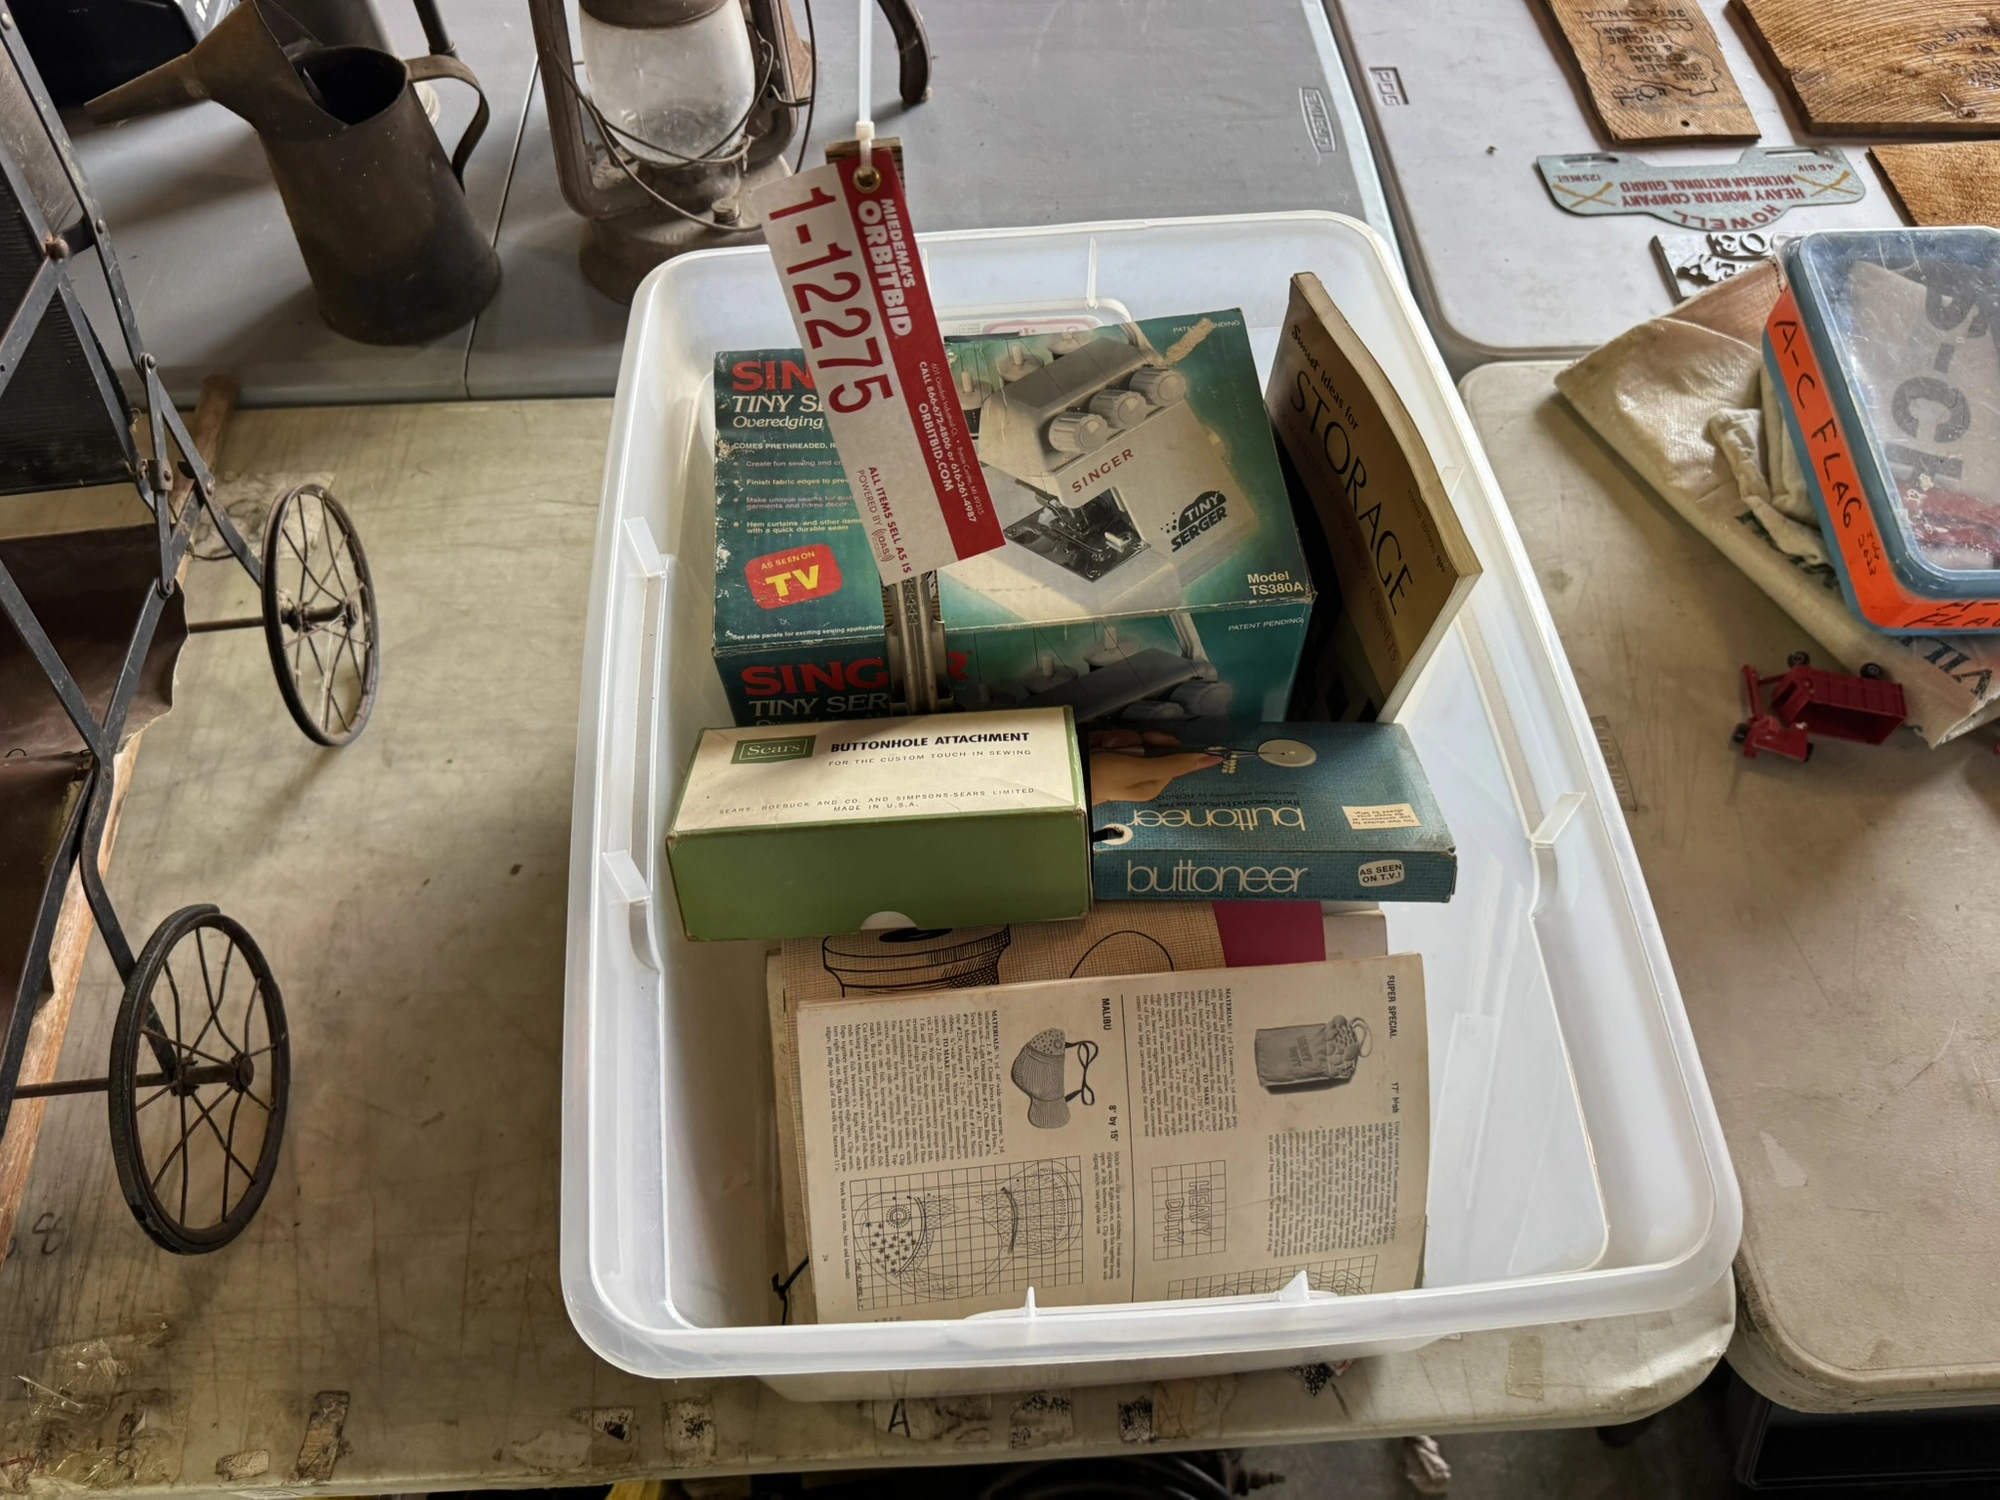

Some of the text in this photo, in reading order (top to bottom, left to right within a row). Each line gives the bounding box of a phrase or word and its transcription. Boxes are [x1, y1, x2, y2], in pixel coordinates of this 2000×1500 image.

[1607, 35, 1664, 44] ENGINE
[1619, 174, 1794, 193] MICHIGAN NATIONAL GUARD
[1621, 187, 1805, 207] HEAVY MORTAR COMPANY
[1671, 205, 1780, 230] HOWELL
[880, 197, 916, 289] MIEDEMA'S
[856, 200, 914, 338] ORBITBID
[768, 186, 894, 414] 1-12275
[732, 359, 817, 393] SIN
[1291, 323, 1360, 430] Sunset Ideas for
[732, 394, 796, 413] TINY
[733, 415, 824, 430] Overedging
[1773, 319, 1862, 529] A-C FLAG
[733, 442, 763, 450] COMES
[765, 442, 828, 450] PRETHREADED,
[918, 360, 977, 524] CALL 866-672-4806 or 616-261-4987
[918, 401, 954, 492] ORBITBID.COM
[745, 460, 771, 468] Create
[1071, 448, 1134, 494] SINGER
[796, 478, 820, 486] edges
[855, 468, 877, 514] POWERED
[871, 514, 882, 527] BY
[1290, 370, 1413, 615] STORAGE
[1184, 491, 1222, 520] TINY
[867, 464, 911, 574] ALL ITEMS SELL AS IS
[772, 526, 794, 535] quick
[1171, 505, 1229, 554] SERGER
[761, 551, 816, 570] AS SEEN ON
[765, 564, 821, 597] TV
[1247, 570, 1290, 585] Model
[1249, 581, 1304, 596] TS380A
[762, 631, 784, 639] panels
[795, 629, 821, 637] exciting
[821, 628, 845, 636] sewing
[1228, 617, 1303, 632] PATENT PENDING
[749, 692, 890, 717] TINY SER
[745, 740, 802, 757] Sears
[830, 732, 1030, 753] BUTTONHOLE ATTACHMENT
[880, 754, 926, 763] CUSTOM
[930, 751, 967, 760] TOUCH
[989, 749, 1032, 757] SEWING
[895, 789, 986, 802] SIMPSONS-SEARS
[992, 787, 1035, 796] LIMITED
[833, 801, 920, 813] MADE IN U.S.A.
[1130, 806, 1307, 832] buttoneer
[1126, 859, 1309, 893] buttoneer
[1359, 863, 1402, 876] AS SEEN
[1362, 875, 1377, 883] ON
[1101, 998, 1112, 1031] MALIBU
[1387, 974, 1398, 1039] SUPER SPECIAL
[942, 1037, 948, 1047] TO
[1203, 1074, 1209, 1084] TO
[1108, 1116, 1117, 1126] by
[1188, 1180, 1212, 1236] HEAVY
[1163, 1198, 1185, 1244] DUTY
[822, 1254, 829, 1262] 24
